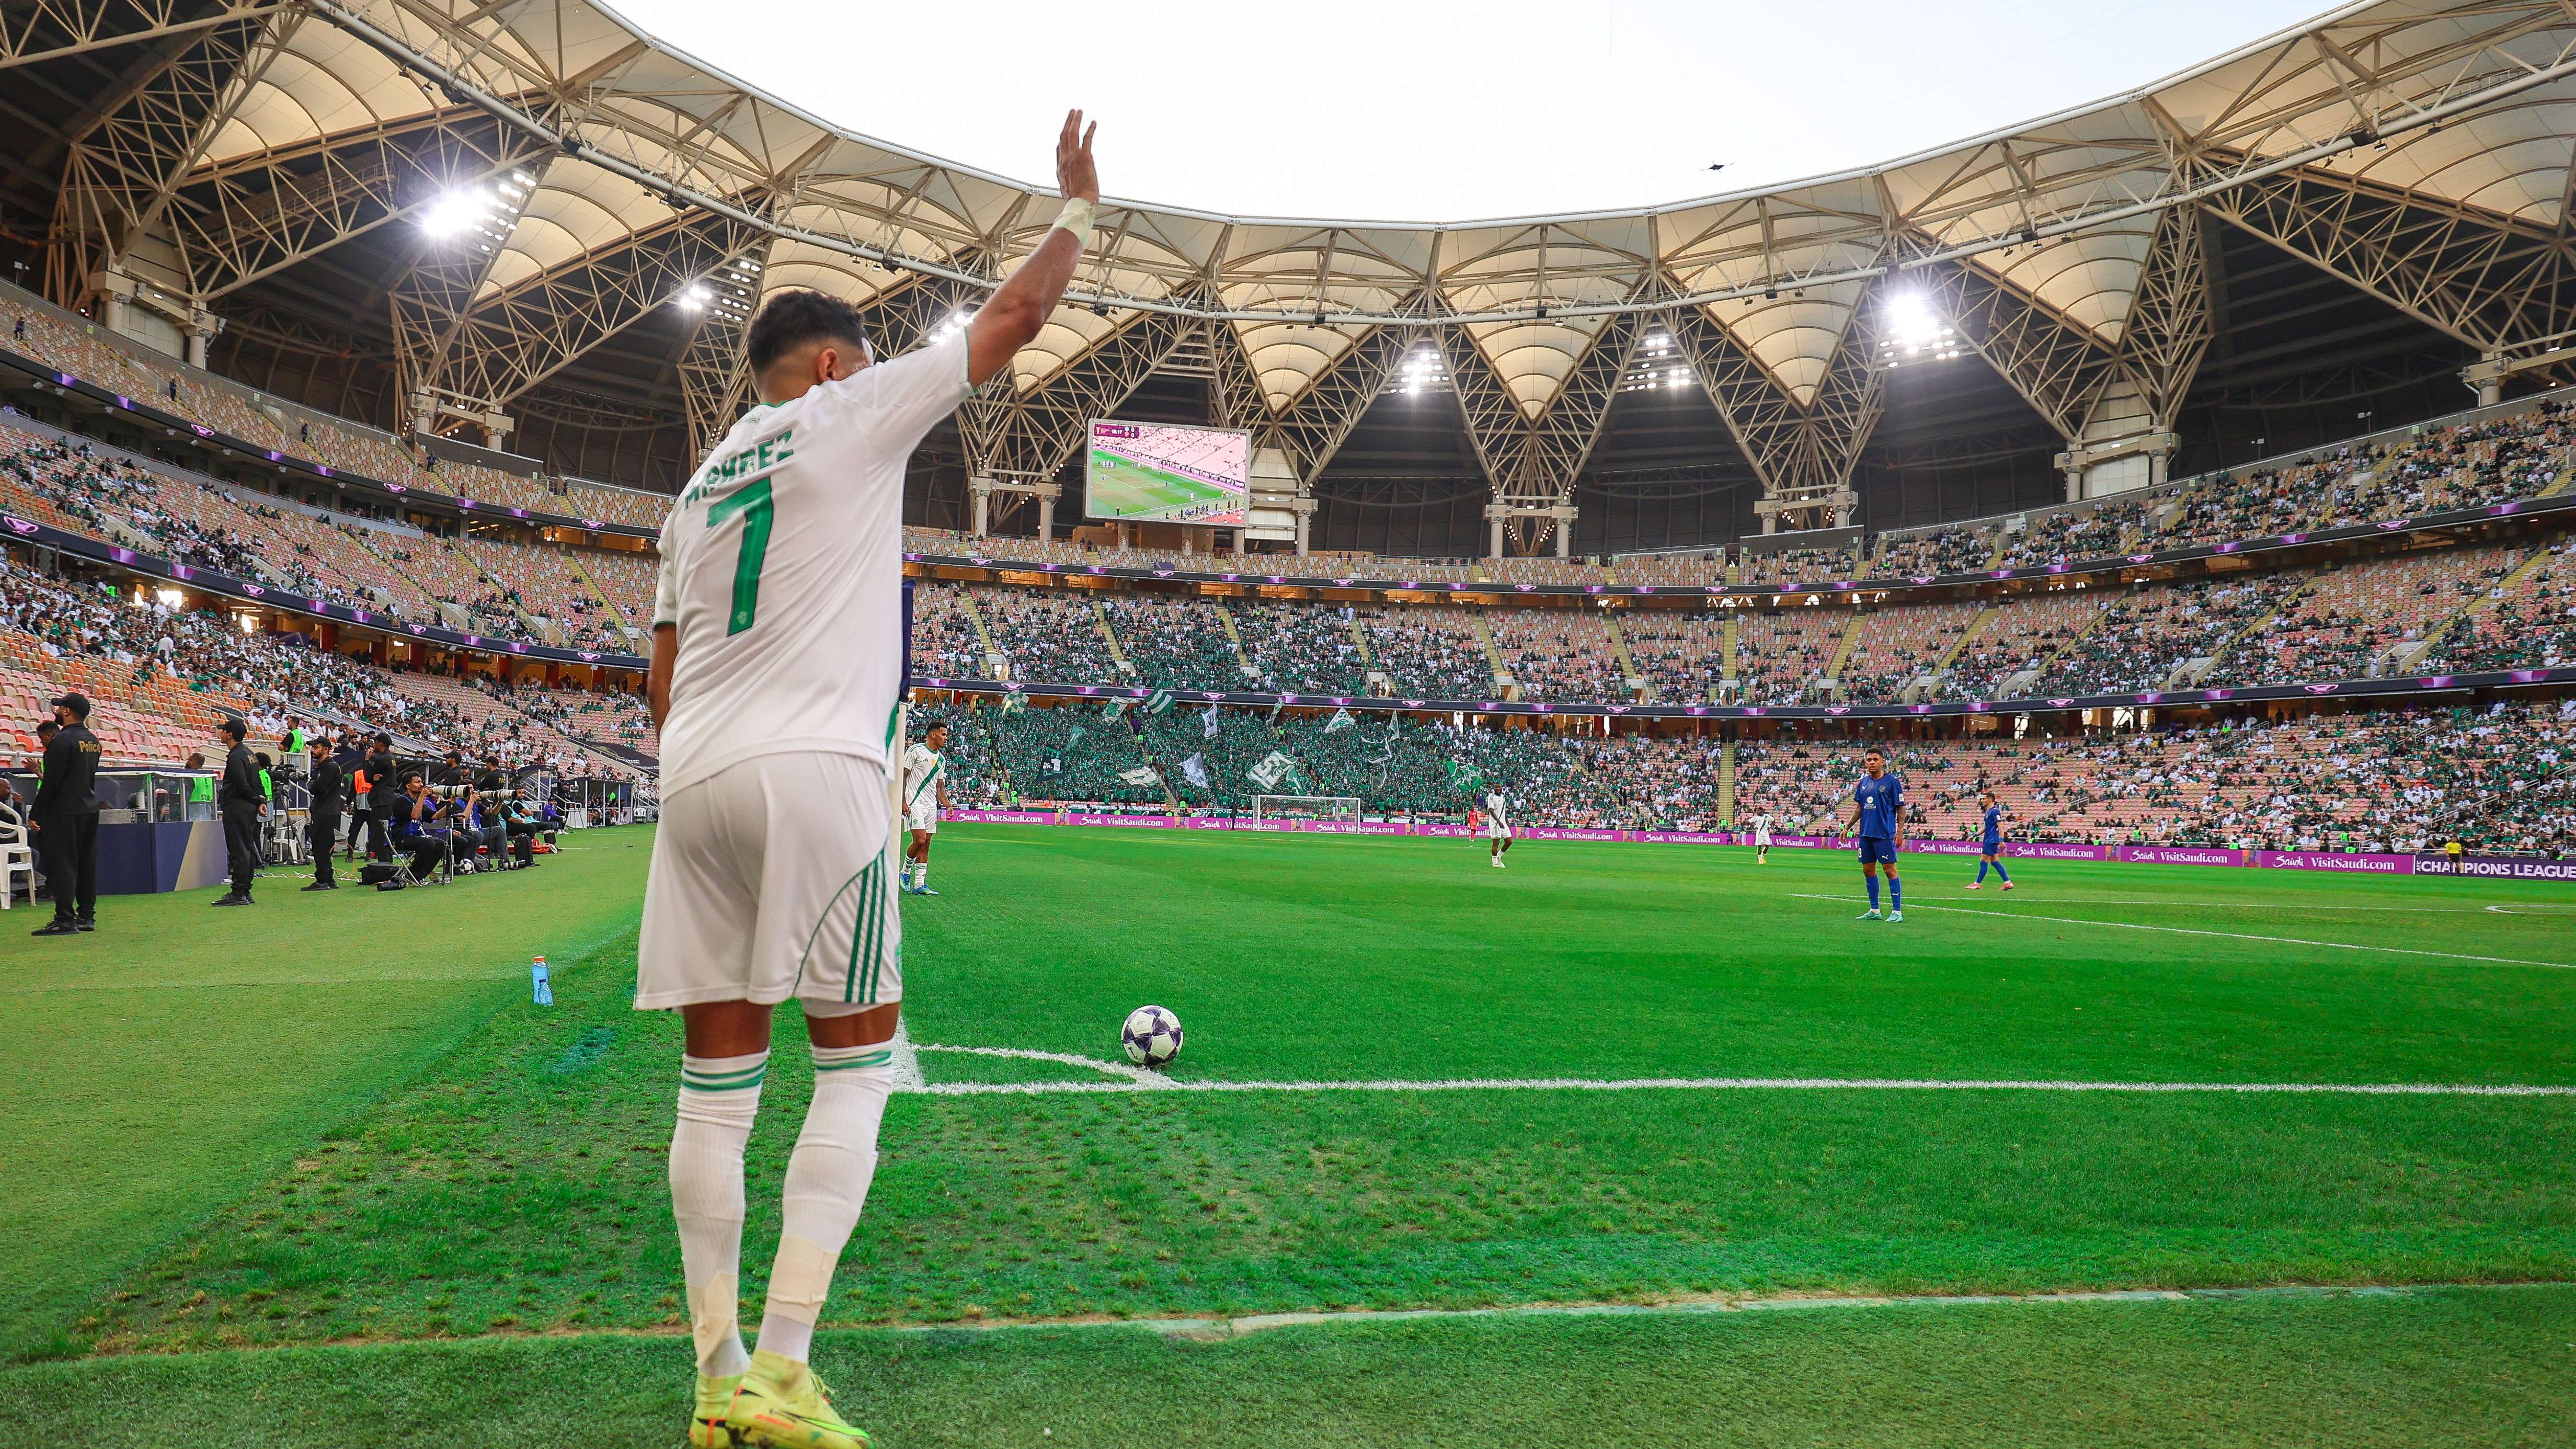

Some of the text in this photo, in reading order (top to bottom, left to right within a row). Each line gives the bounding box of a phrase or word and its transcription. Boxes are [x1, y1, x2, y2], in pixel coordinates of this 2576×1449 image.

[706, 476, 774, 636] 7
[78, 740, 101, 752] Police
[957, 813, 1043, 823] Saudi VisitSaudi.com
[1079, 816, 1163, 826] Saudi VisitSaudi.com
[1198, 819, 1220, 829] Saudi
[1314, 823, 1336, 832] Saudi
[1428, 826, 1449, 835] Saudi
[1537, 830, 1613, 840] Saudi VisitSaudi.com
[1644, 834, 1720, 843] Saudi VisitSaudi.com
[1776, 838, 1814, 847] VisitSaudi.com
[1919, 843, 1936, 852] Saudi
[2016, 846, 2094, 858] Saudi VisitSaudi.com
[2131, 849, 2227, 863] Saudi VisitSaudi.com
[2273, 854, 2395, 870] Saudi VisitSaudi.com
[2514, 864, 2576, 878] LEAGUE
